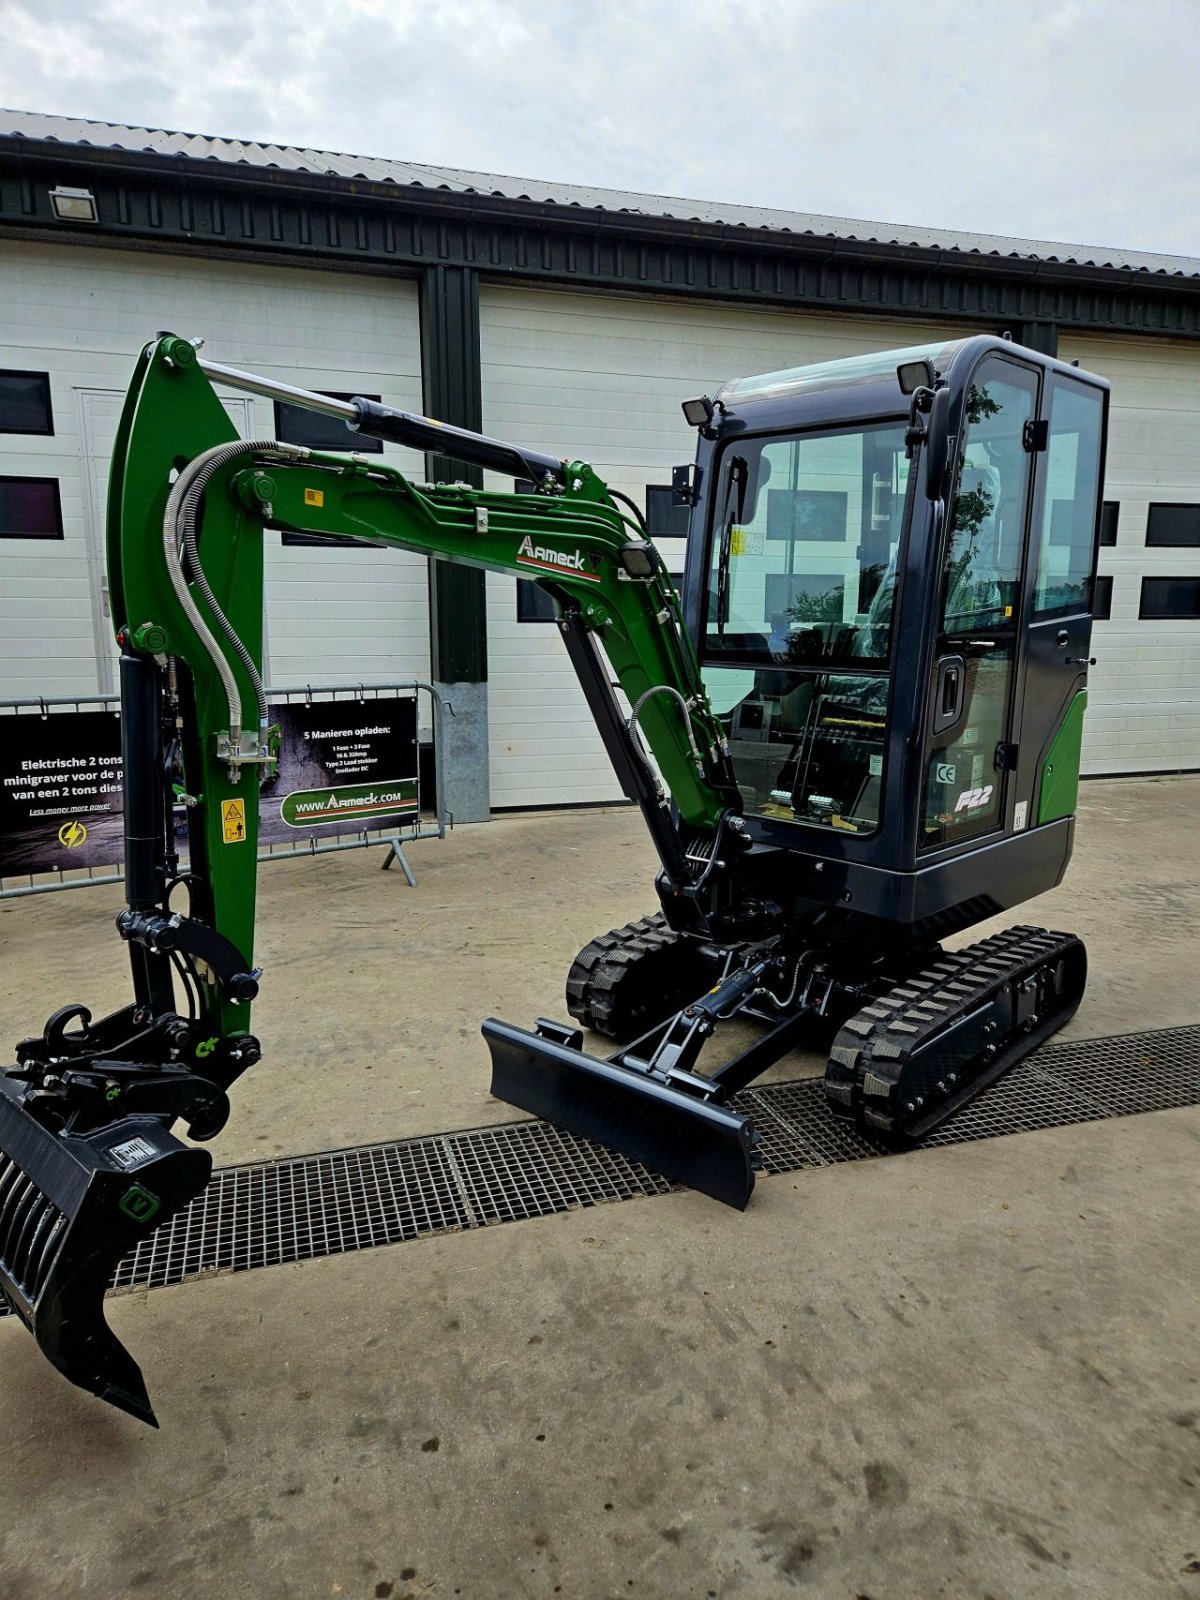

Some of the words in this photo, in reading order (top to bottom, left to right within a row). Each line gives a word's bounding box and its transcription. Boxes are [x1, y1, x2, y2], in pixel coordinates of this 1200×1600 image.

[304, 731, 310, 740] 5
[311, 729, 353, 739] Manieren
[354, 725, 391, 737] opladen:
[21, 758, 87, 770] Elektrische
[89, 757, 96, 766] 2
[98, 756, 123, 765] tons
[4, 774, 69, 787] minigraver
[72, 773, 98, 781] voor
[100, 770, 114, 779] de
[938, 766, 955, 782] CE
[12, 791, 35, 800] van
[37, 789, 59, 798] een
[62, 787, 70, 796] 2
[72, 786, 97, 795] tons
[954, 785, 993, 812] F22
[46, 806, 69, 815] money
[89, 803, 112, 811] power
